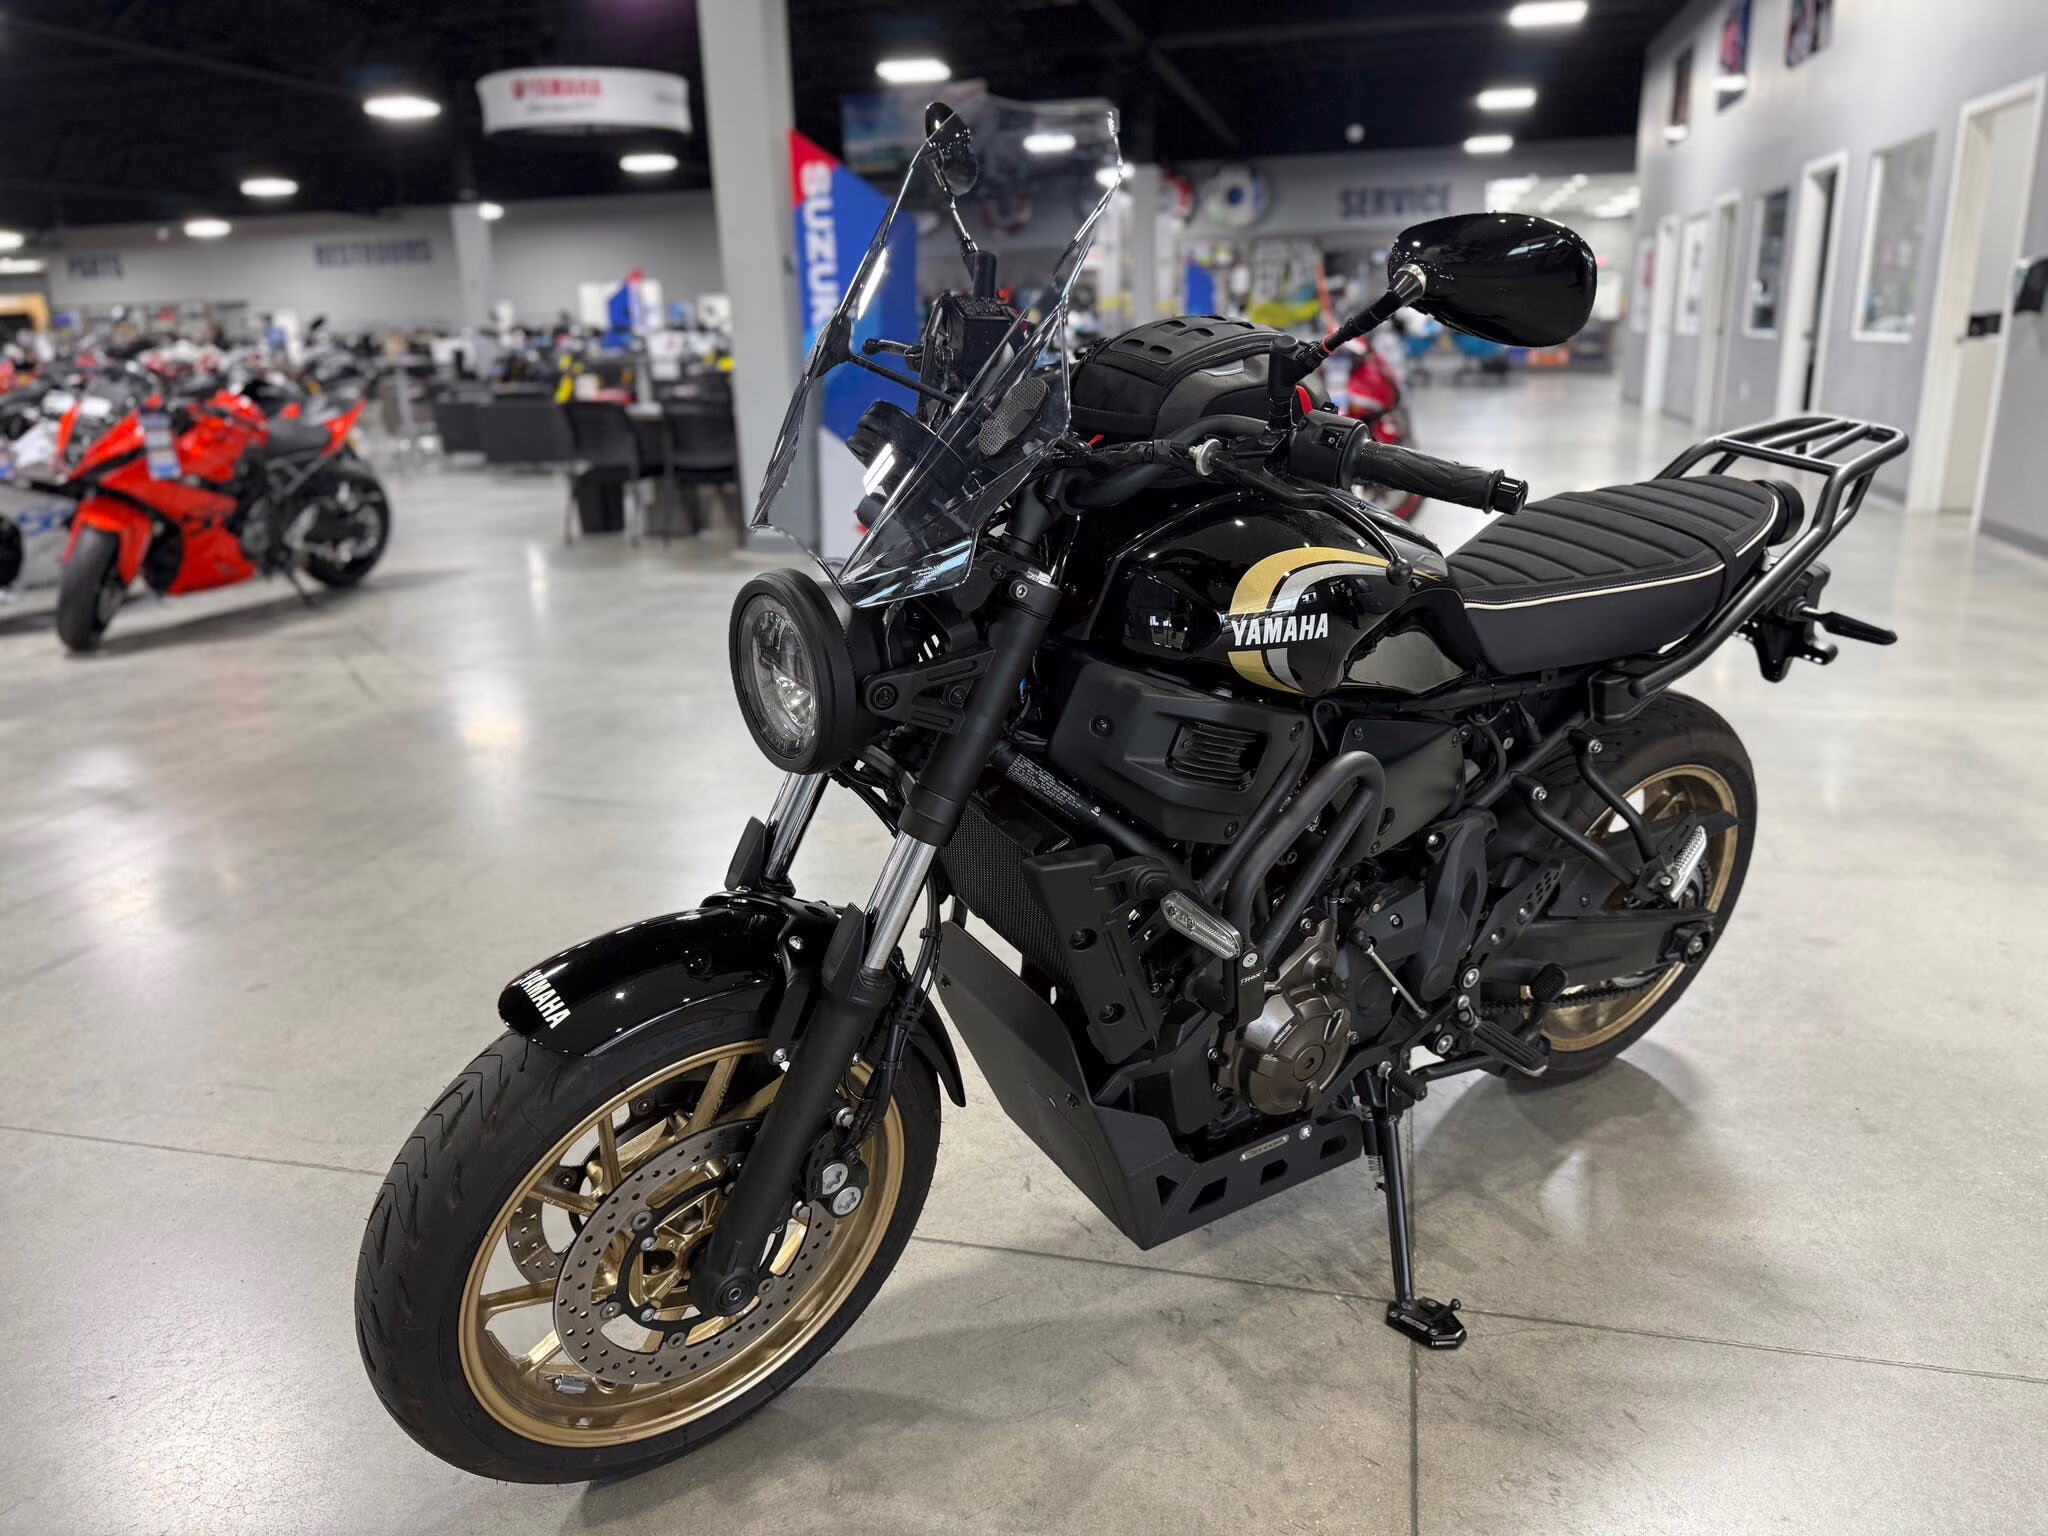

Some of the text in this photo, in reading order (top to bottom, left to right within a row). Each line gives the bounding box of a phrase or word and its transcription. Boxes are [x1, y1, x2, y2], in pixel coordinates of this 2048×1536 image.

[800, 160, 840, 327] SUZUK
[1231, 613, 1328, 646] YAMAHA
[519, 970, 571, 1029] YAMAHA
